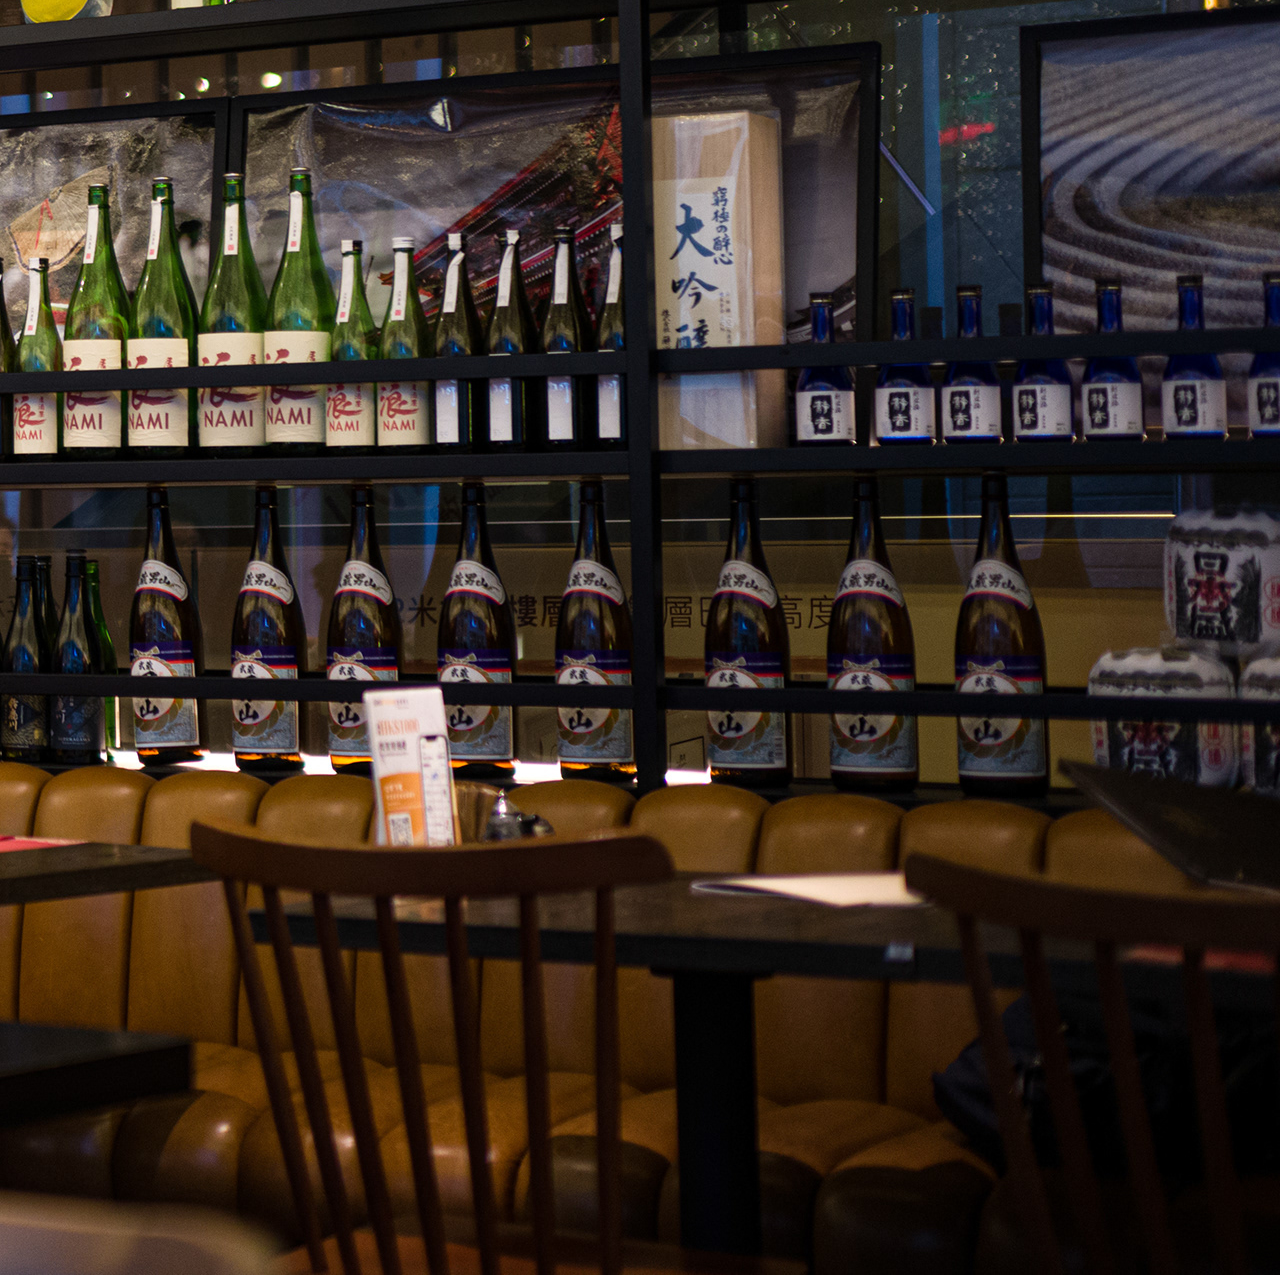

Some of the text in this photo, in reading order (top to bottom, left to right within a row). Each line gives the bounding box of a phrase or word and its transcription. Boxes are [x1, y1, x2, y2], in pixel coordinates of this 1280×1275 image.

[64, 413, 102, 430] NAMI
[129, 412, 169, 429] NAMI
[204, 410, 253, 427] NAMI
[267, 408, 311, 425] NAMI
[329, 421, 359, 432] NAMI
[383, 420, 415, 431] NAMI
[15, 430, 42, 440] NAMI
[140, 571, 170, 586] 蔵男山
[245, 572, 277, 587] 蔵男山
[339, 573, 377, 589] 蔵男山
[449, 572, 489, 588] 蔵男山
[567, 572, 607, 588] 蔵男山
[718, 573, 759, 590] 蔵男山
[968, 573, 1017, 590] 蔵男山
